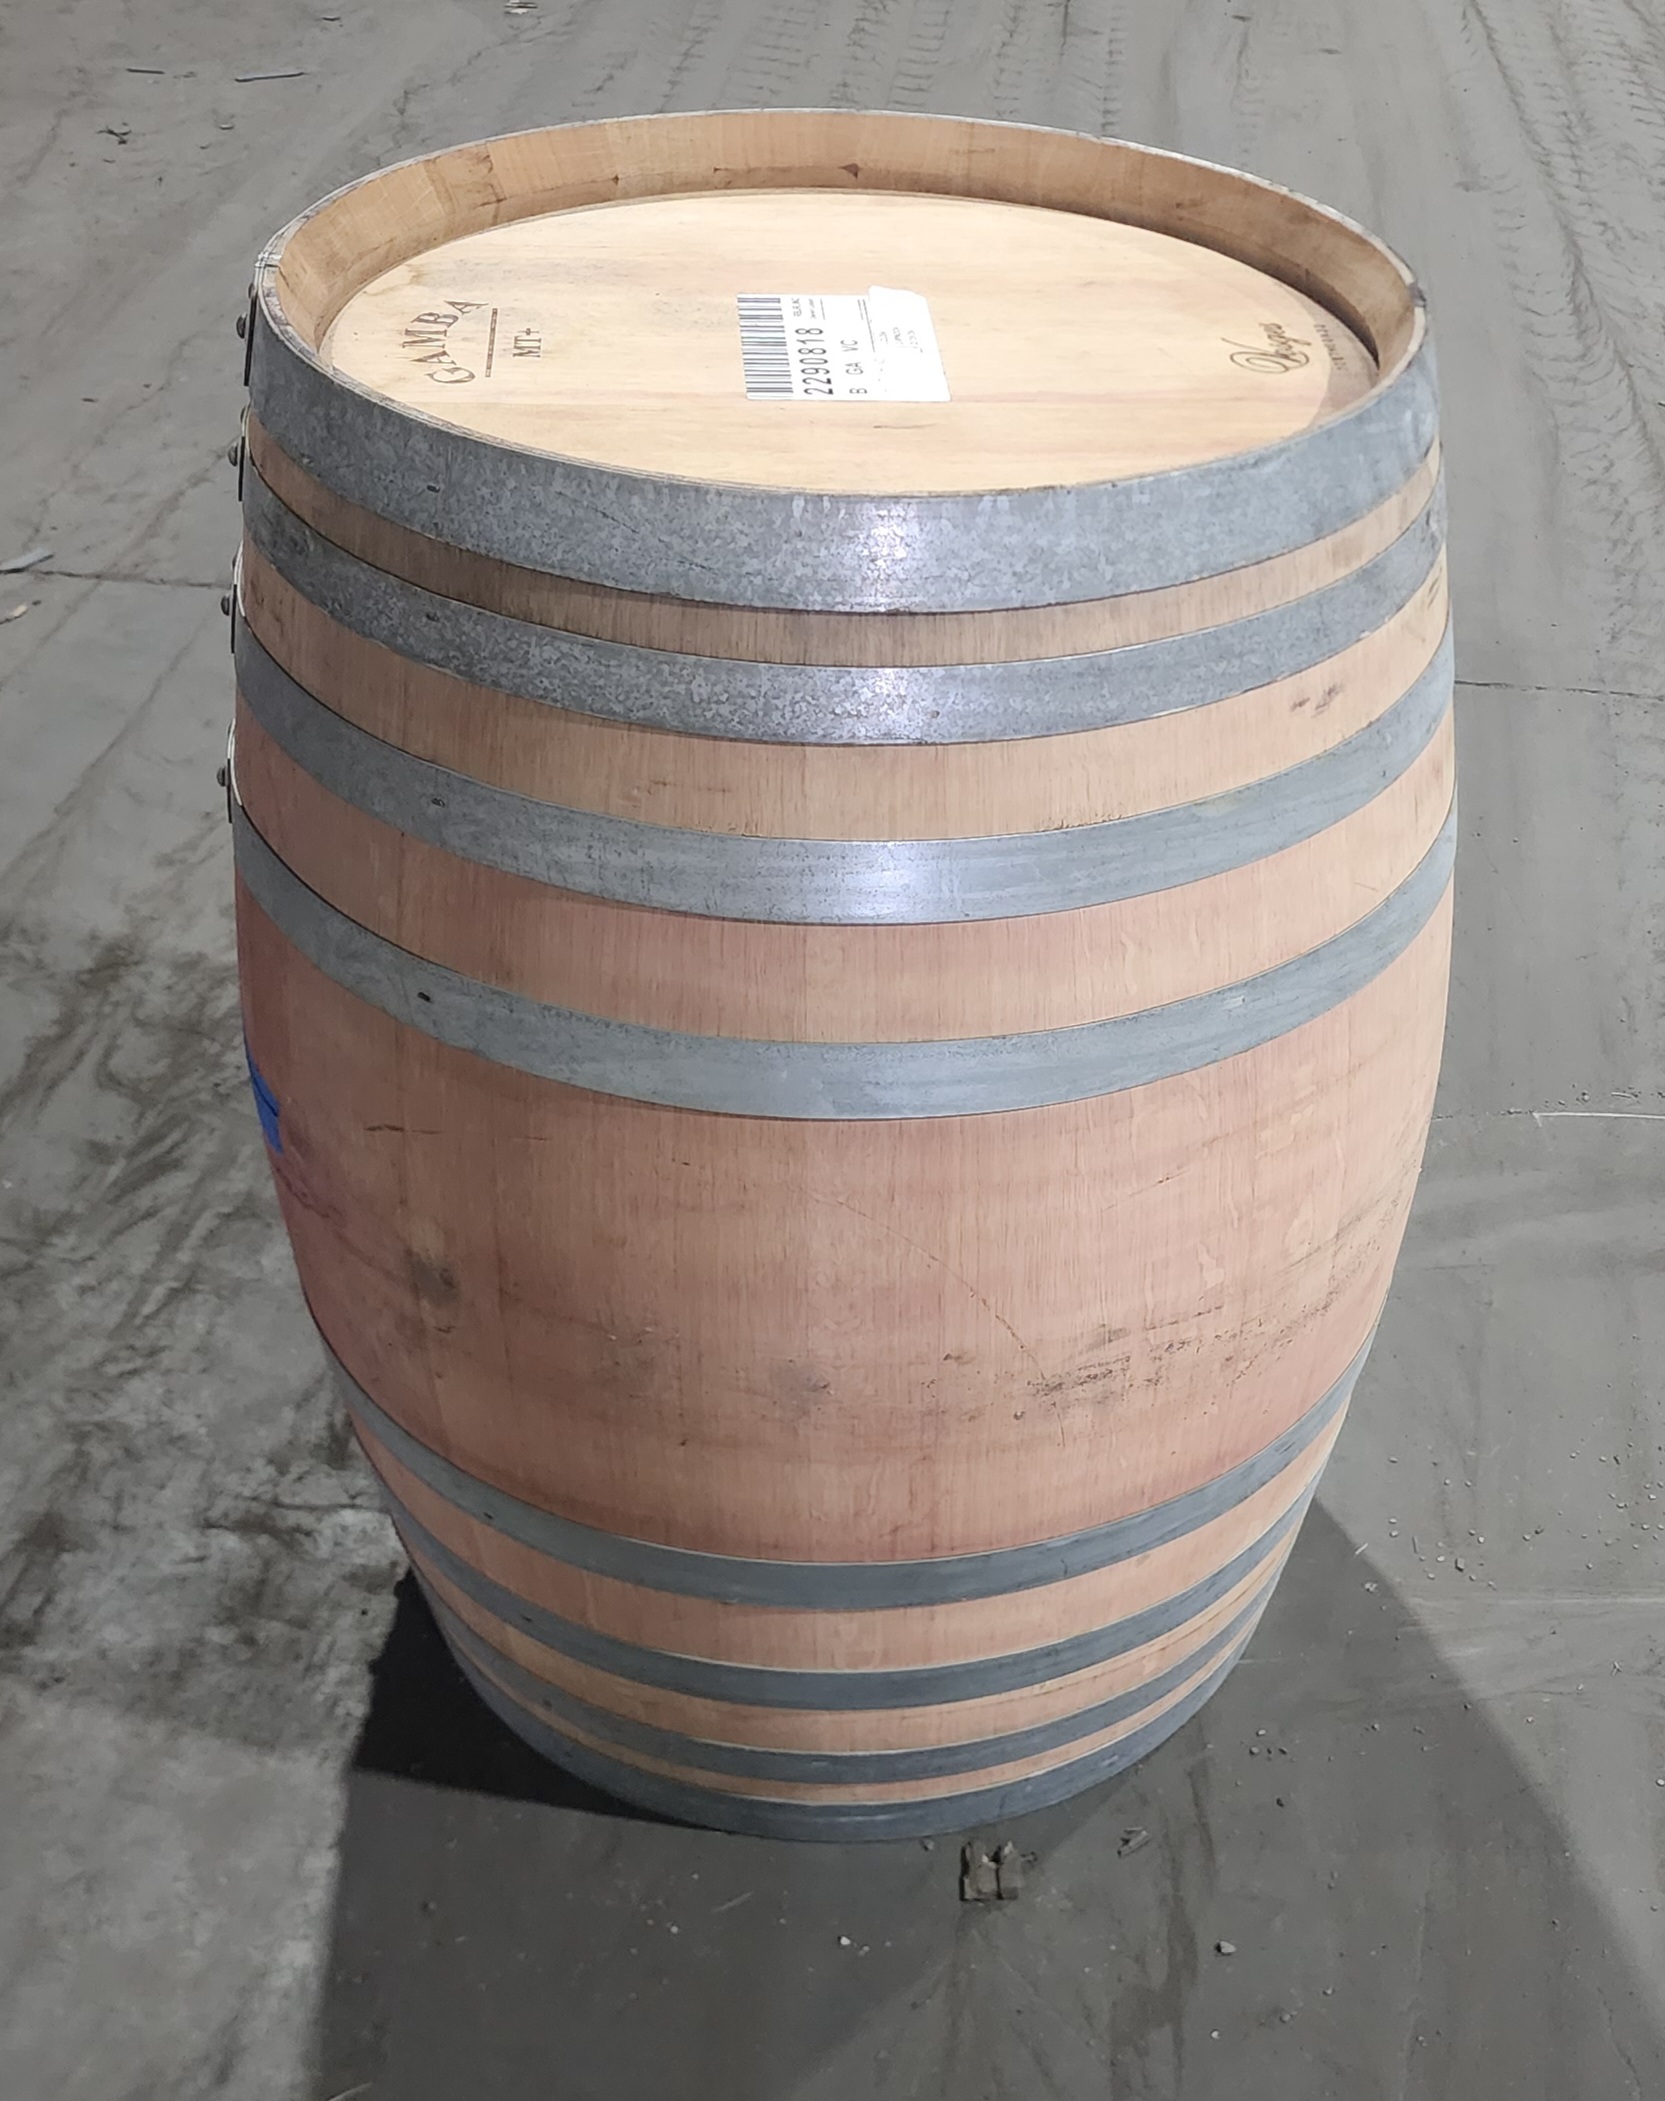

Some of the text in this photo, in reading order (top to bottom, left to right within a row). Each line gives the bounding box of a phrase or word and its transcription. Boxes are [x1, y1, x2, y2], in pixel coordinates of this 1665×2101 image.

[401, 300, 489, 384] GAMBA
[512, 328, 542, 358] MT+
[840, 339, 859, 352] VC
[795, 327, 833, 395] 2290818
[845, 362, 864, 375] GA
